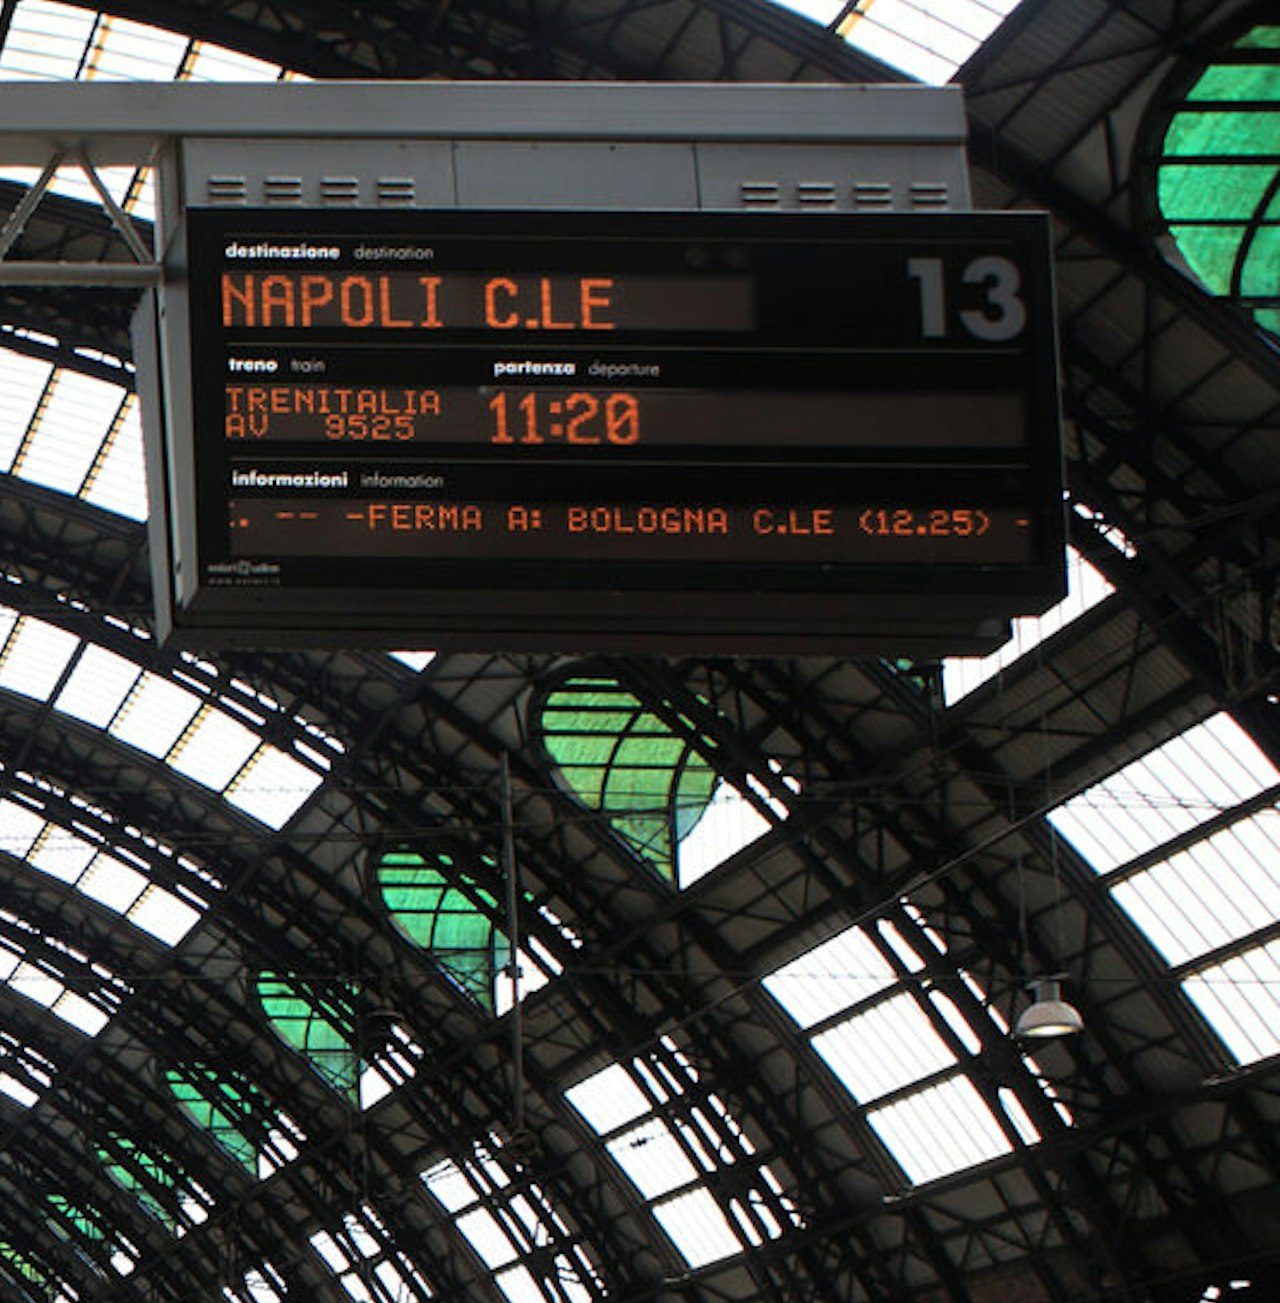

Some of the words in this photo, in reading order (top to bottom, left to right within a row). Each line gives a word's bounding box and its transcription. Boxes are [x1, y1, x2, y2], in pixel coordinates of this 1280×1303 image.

[225, 244, 340, 261] destinazione
[354, 245, 434, 261] destination
[222, 274, 443, 328] NAPOLI
[484, 276, 615, 330] C.LE
[907, 256, 1028, 342] 13
[229, 358, 278, 373] treno
[290, 358, 326, 373] train
[493, 360, 576, 377] partenza
[588, 361, 660, 379] departure
[225, 387, 440, 415] TRENITALIA
[225, 414, 270, 438] AV
[325, 415, 416, 441] 9525
[489, 392, 639, 444] 11:20
[231, 471, 348, 489] informazioni
[360, 472, 444, 489] information
[507, 506, 542, 532] A:
[568, 506, 728, 535] BOLOGNA
[752, 509, 834, 536] C.LE
[858, 508, 990, 537] (12.25)
